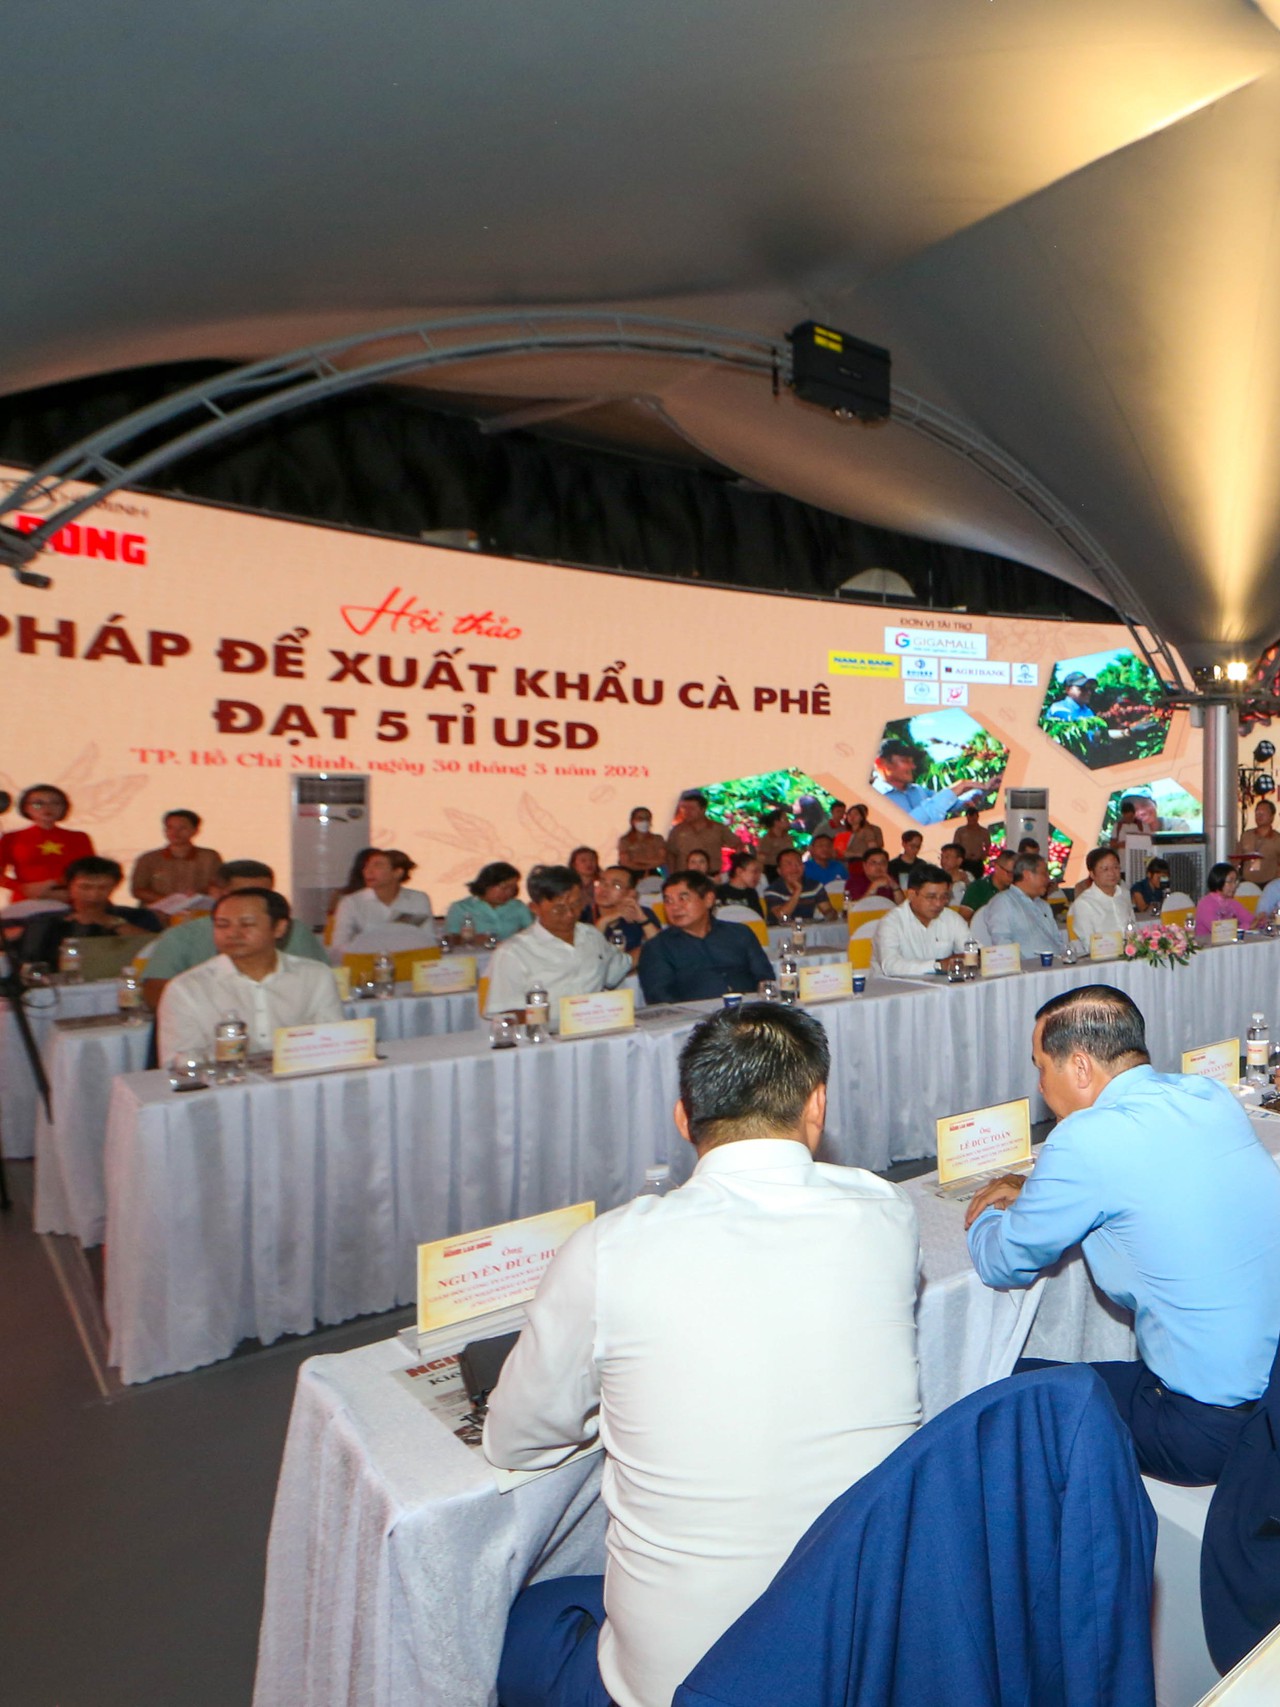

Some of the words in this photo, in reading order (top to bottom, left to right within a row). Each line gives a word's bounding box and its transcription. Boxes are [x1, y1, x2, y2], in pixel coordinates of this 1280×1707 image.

[340, 586, 441, 636] Hội
[452, 610, 523, 641] thảo
[913, 635, 976, 650] GIGAMALL
[0, 614, 191, 667] HÁP
[216, 626, 310, 679] ĐỂ
[328, 648, 497, 694] XUẤT
[514, 660, 664, 707] KHẨU
[678, 675, 740, 711] CÀ
[753, 683, 831, 715] PHÊ
[833, 657, 857, 665] NAM
[867, 659, 894, 667] BANK
[955, 667, 1006, 678] AGRIBANK
[212, 699, 356, 746] ĐẠT
[376, 711, 409, 742] 5
[428, 703, 475, 745] TỈ
[493, 717, 599, 750] USD
[130, 747, 181, 765] TP.
[367, 757, 425, 775] ngày
[432, 758, 461, 773] 30
[468, 760, 528, 777] tháng
[534, 763, 547, 776] 3
[554, 763, 597, 776] năm
[604, 765, 650, 778] 2024
